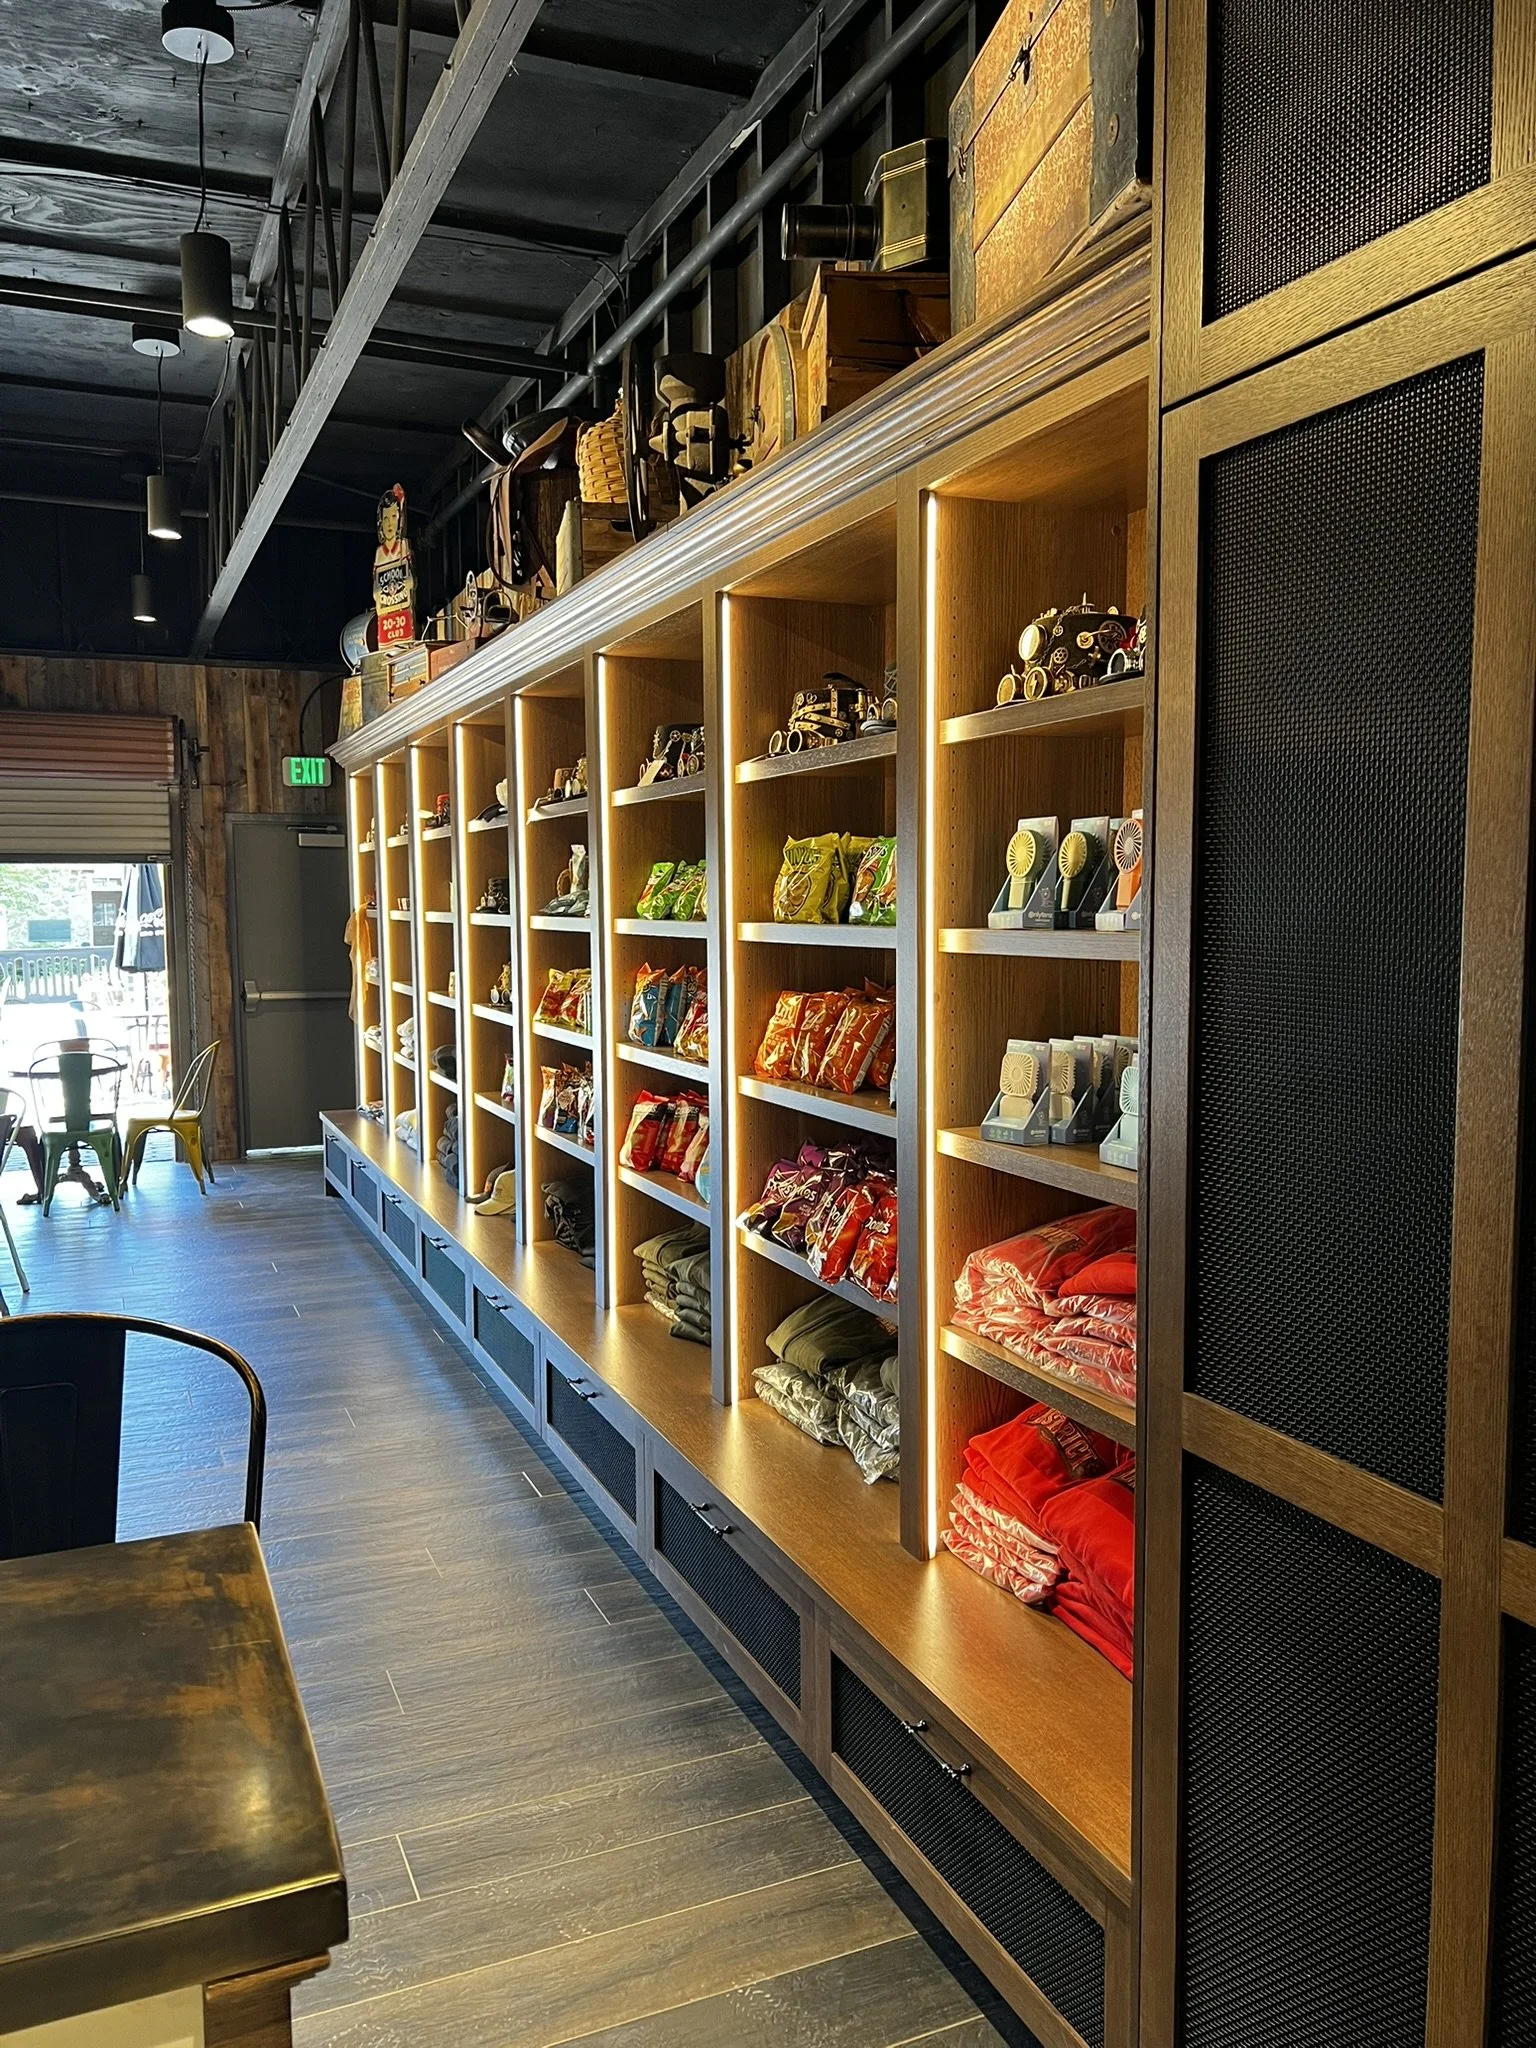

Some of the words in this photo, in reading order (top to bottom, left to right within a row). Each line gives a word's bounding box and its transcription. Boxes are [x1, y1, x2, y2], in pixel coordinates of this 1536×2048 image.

[380, 568, 404, 586] SCHOOL
[380, 588, 409, 606] CROSSING
[383, 615, 406, 631] 20-30
[387, 628, 404, 640] CLUB
[290, 757, 325, 784] EXIT
